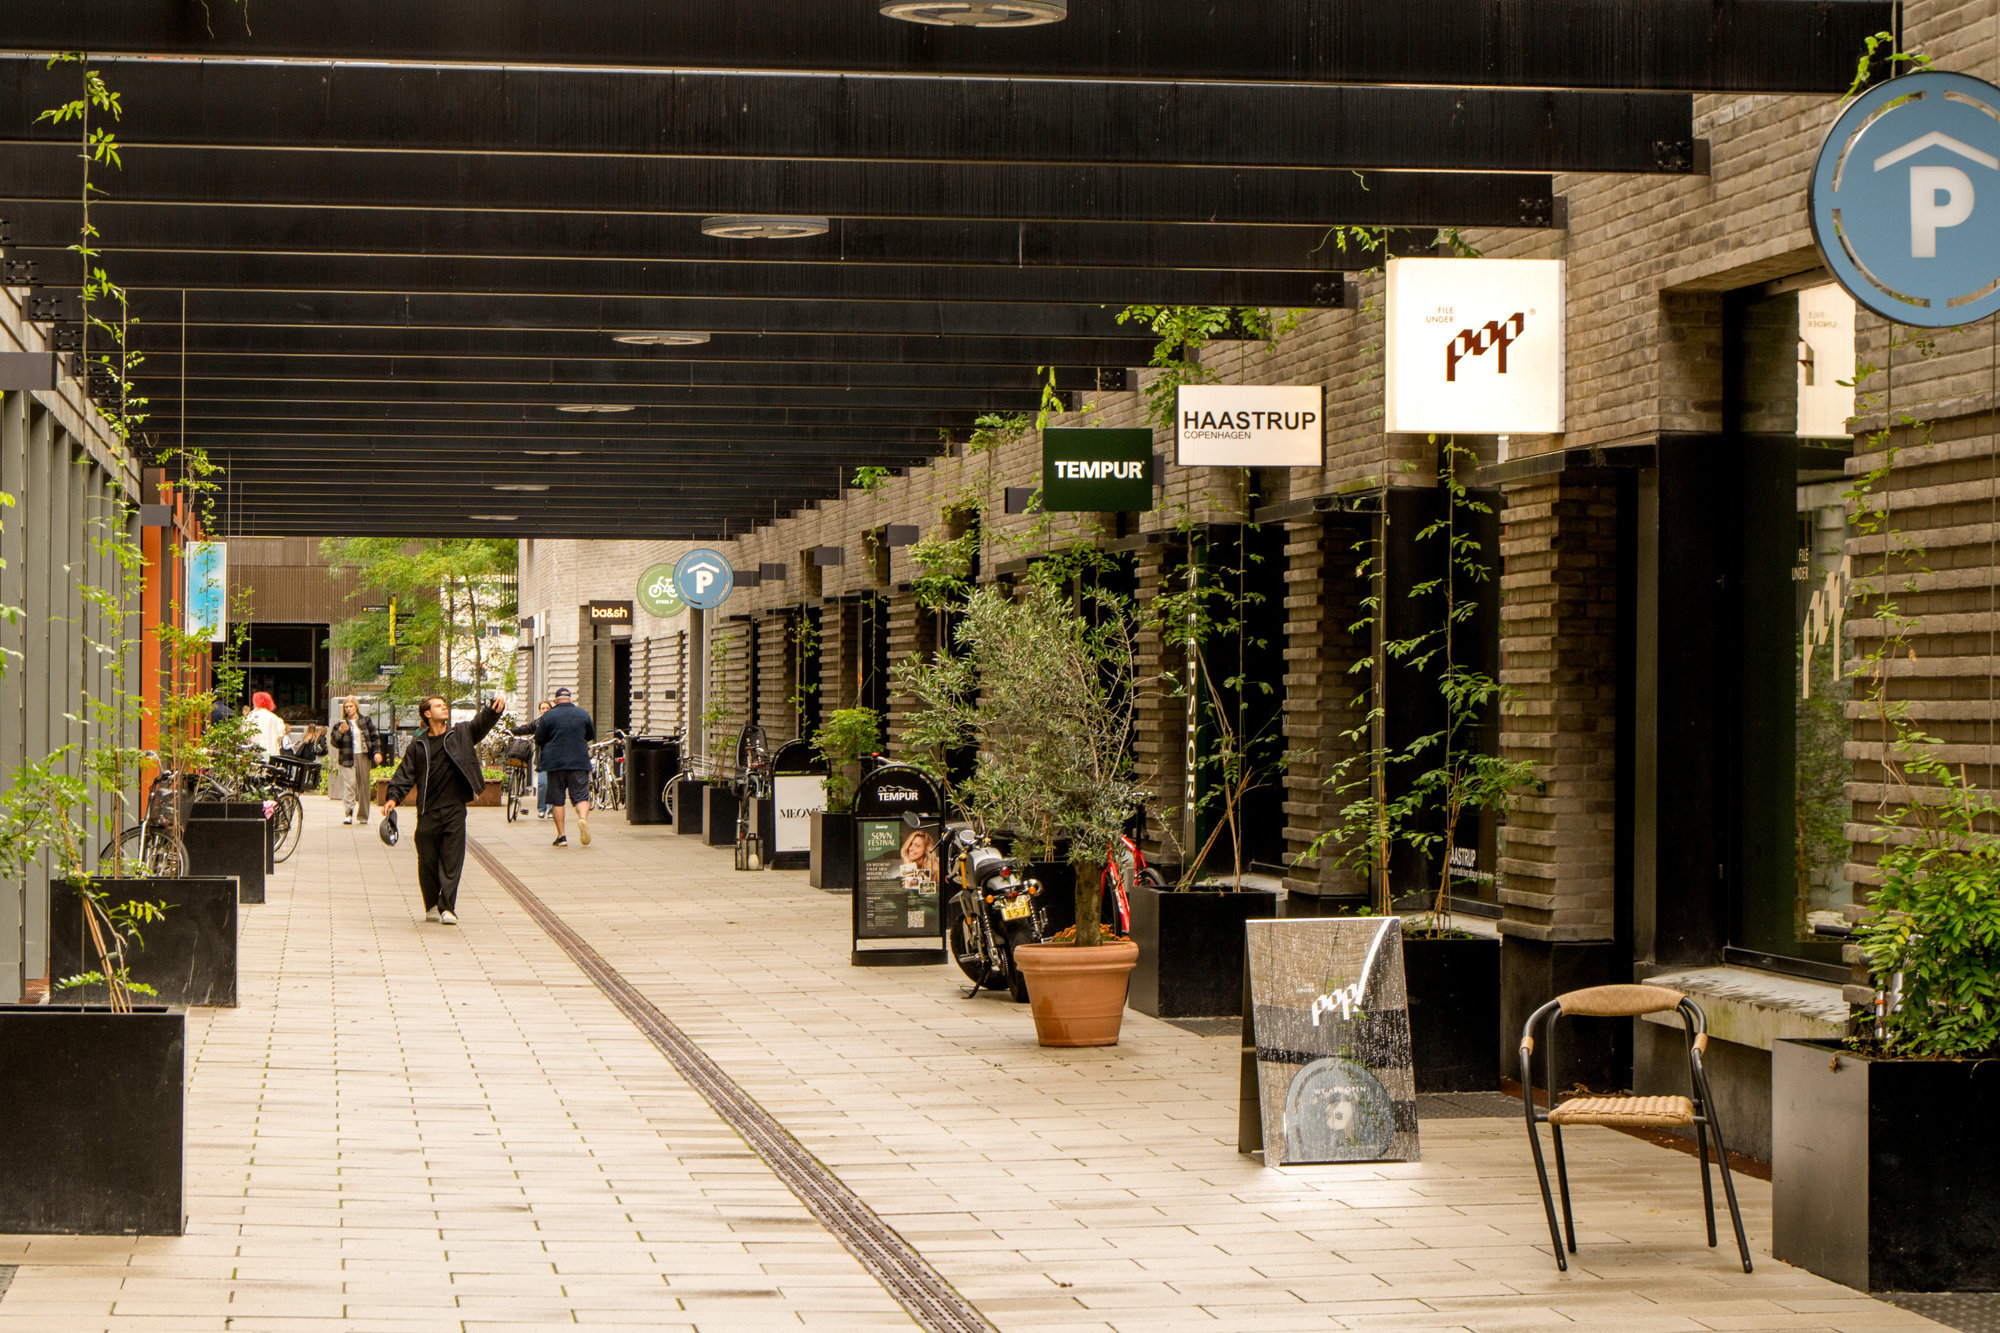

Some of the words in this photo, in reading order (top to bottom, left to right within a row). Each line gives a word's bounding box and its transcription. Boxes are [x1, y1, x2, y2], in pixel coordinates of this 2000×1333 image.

[1909, 165, 1975, 259] P
[1437, 306, 1454, 315] FILE
[1425, 315, 1454, 324] UNDER
[1183, 410, 1317, 431] HAASTRUP
[1183, 430, 1252, 440] COPENHAGEN
[1054, 460, 1143, 480] TEMPUR
[1798, 547, 1809, 562] FILE
[1791, 566, 1809, 581] UNDER
[695, 570, 714, 594] P
[591, 606, 628, 618] ba&sh
[1186, 694, 1197, 823] STORE
[878, 791, 919, 801] TEMPUR
[780, 805, 821, 819] MEO
[867, 839, 896, 847] FESTIVAL
[1449, 846, 1477, 868] AASTRUP
[1344, 1086, 1367, 1095] OPEN
